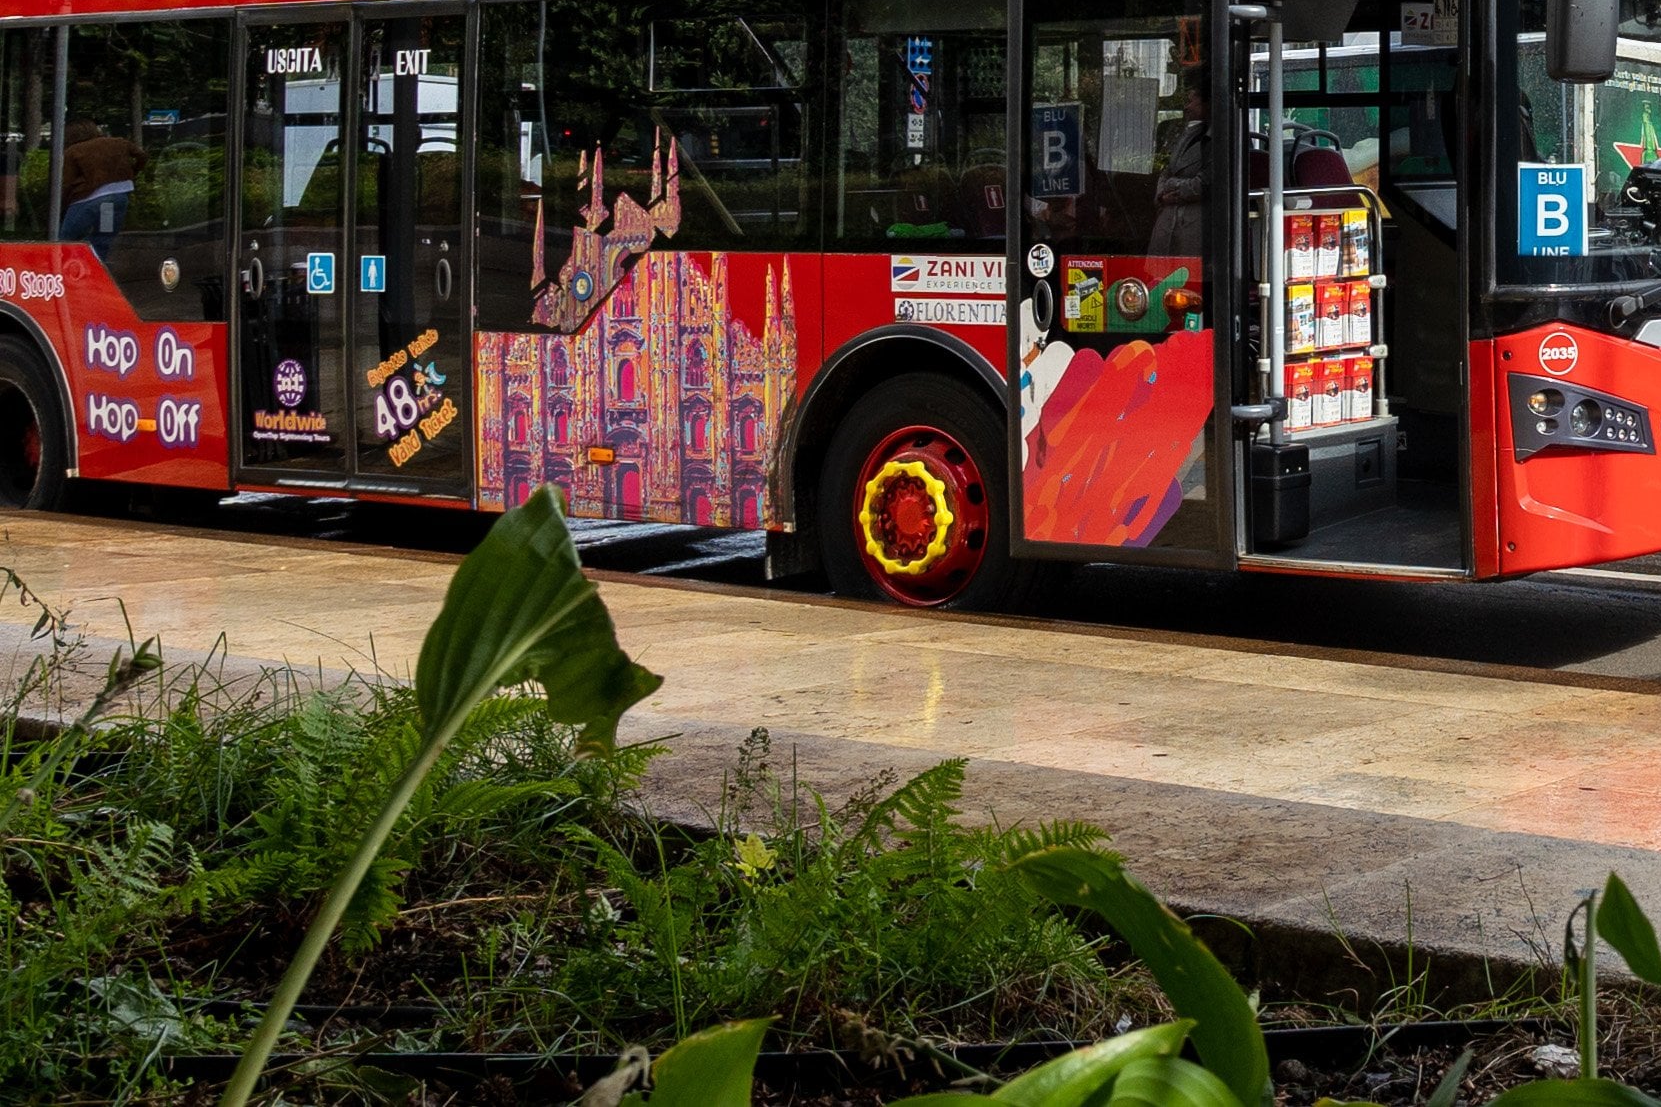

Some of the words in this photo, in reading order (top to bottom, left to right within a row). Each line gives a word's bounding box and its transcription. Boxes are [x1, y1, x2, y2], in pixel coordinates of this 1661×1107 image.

[267, 48, 323, 74] USCITA
[396, 49, 431, 75] EXIT
[1043, 110, 1066, 122] BLU
[1043, 131, 1069, 170] B
[1042, 178, 1070, 192] LINE
[1538, 172, 1567, 185] BLU
[1537, 194, 1569, 236] B
[927, 261, 974, 277] ZANI
[20, 270, 65, 301] Stops
[926, 280, 993, 290] EXPERIENCE
[86, 325, 139, 377] Hop
[156, 329, 194, 378] On
[1542, 347, 1576, 360] 2035
[88, 392, 140, 443] Hop
[157, 397, 201, 445] Off
[375, 378, 419, 438] 48
[254, 410, 326, 430] Worldwide
